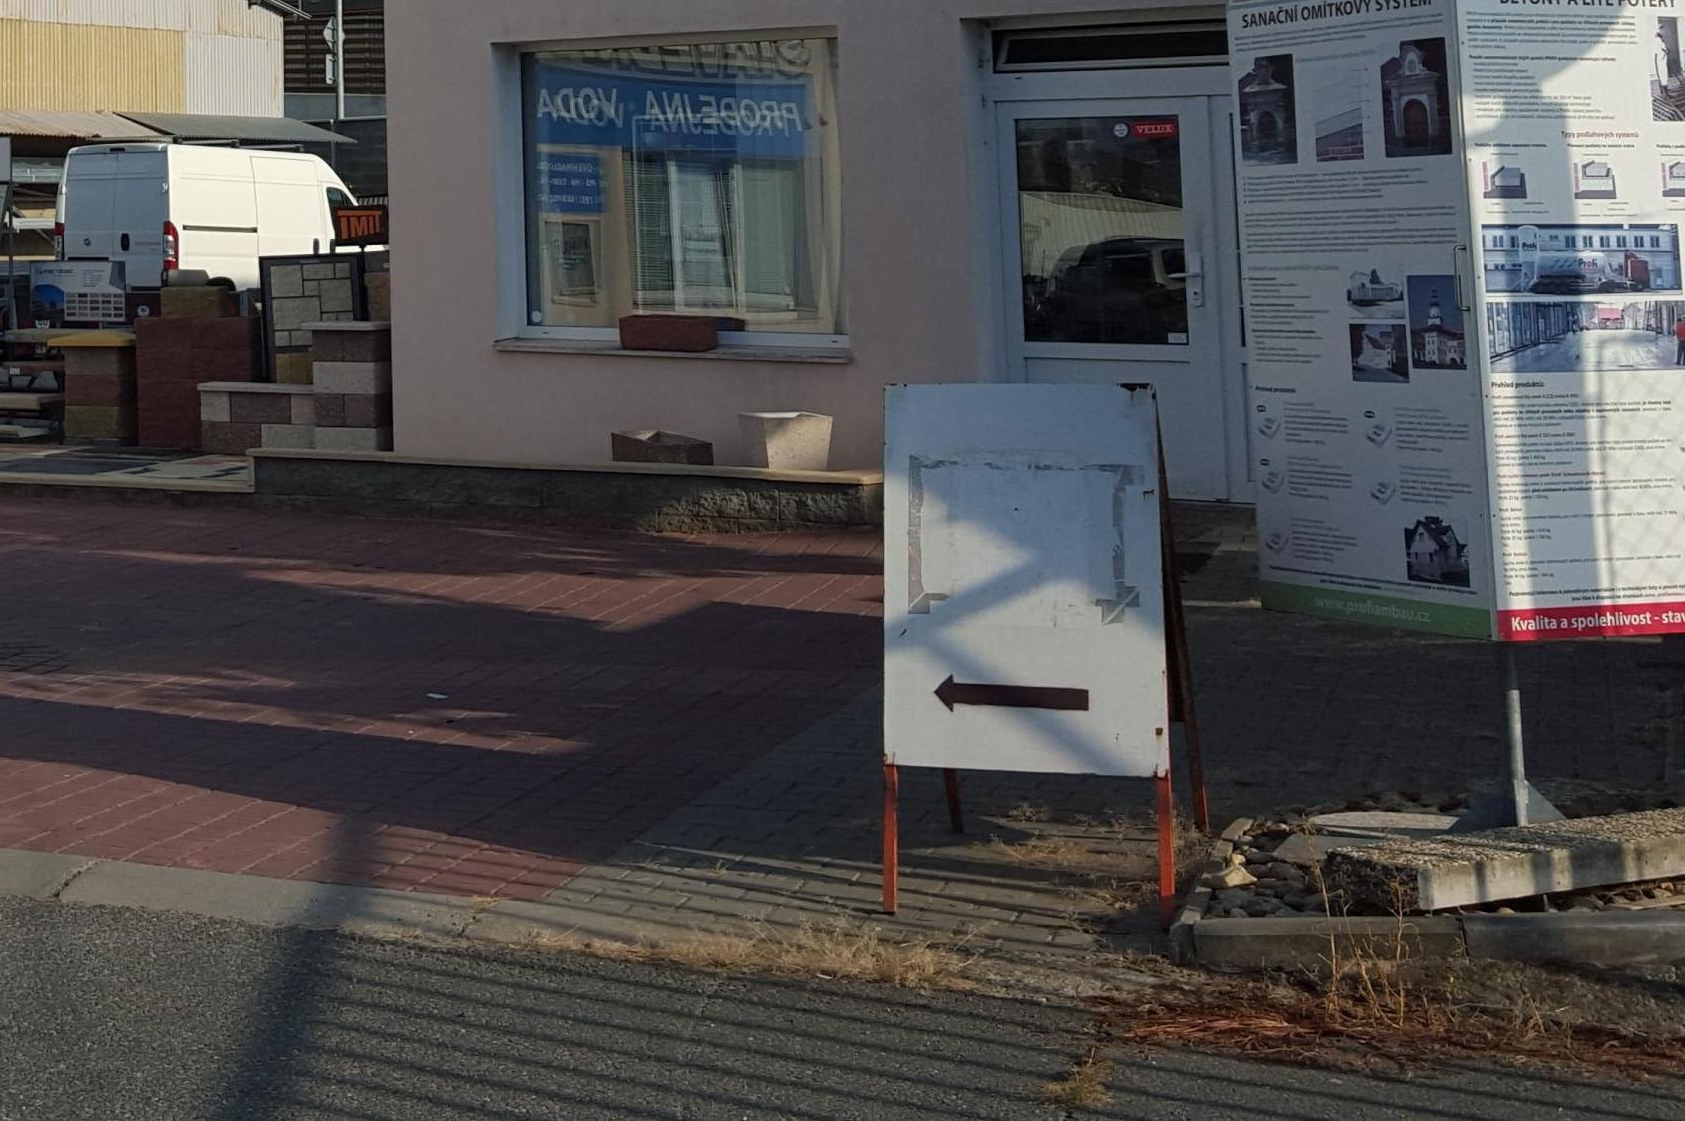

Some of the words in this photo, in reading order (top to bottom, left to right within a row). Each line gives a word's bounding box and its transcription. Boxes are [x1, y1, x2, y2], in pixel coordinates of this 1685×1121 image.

[1242, 4, 1298, 29] SANAČNÍ
[1136, 124, 1173, 133] VELUX
[1511, 616, 1557, 632] Kvalita
[1559, 619, 1568, 629] a
[1571, 611, 1652, 631] spolehlivost
